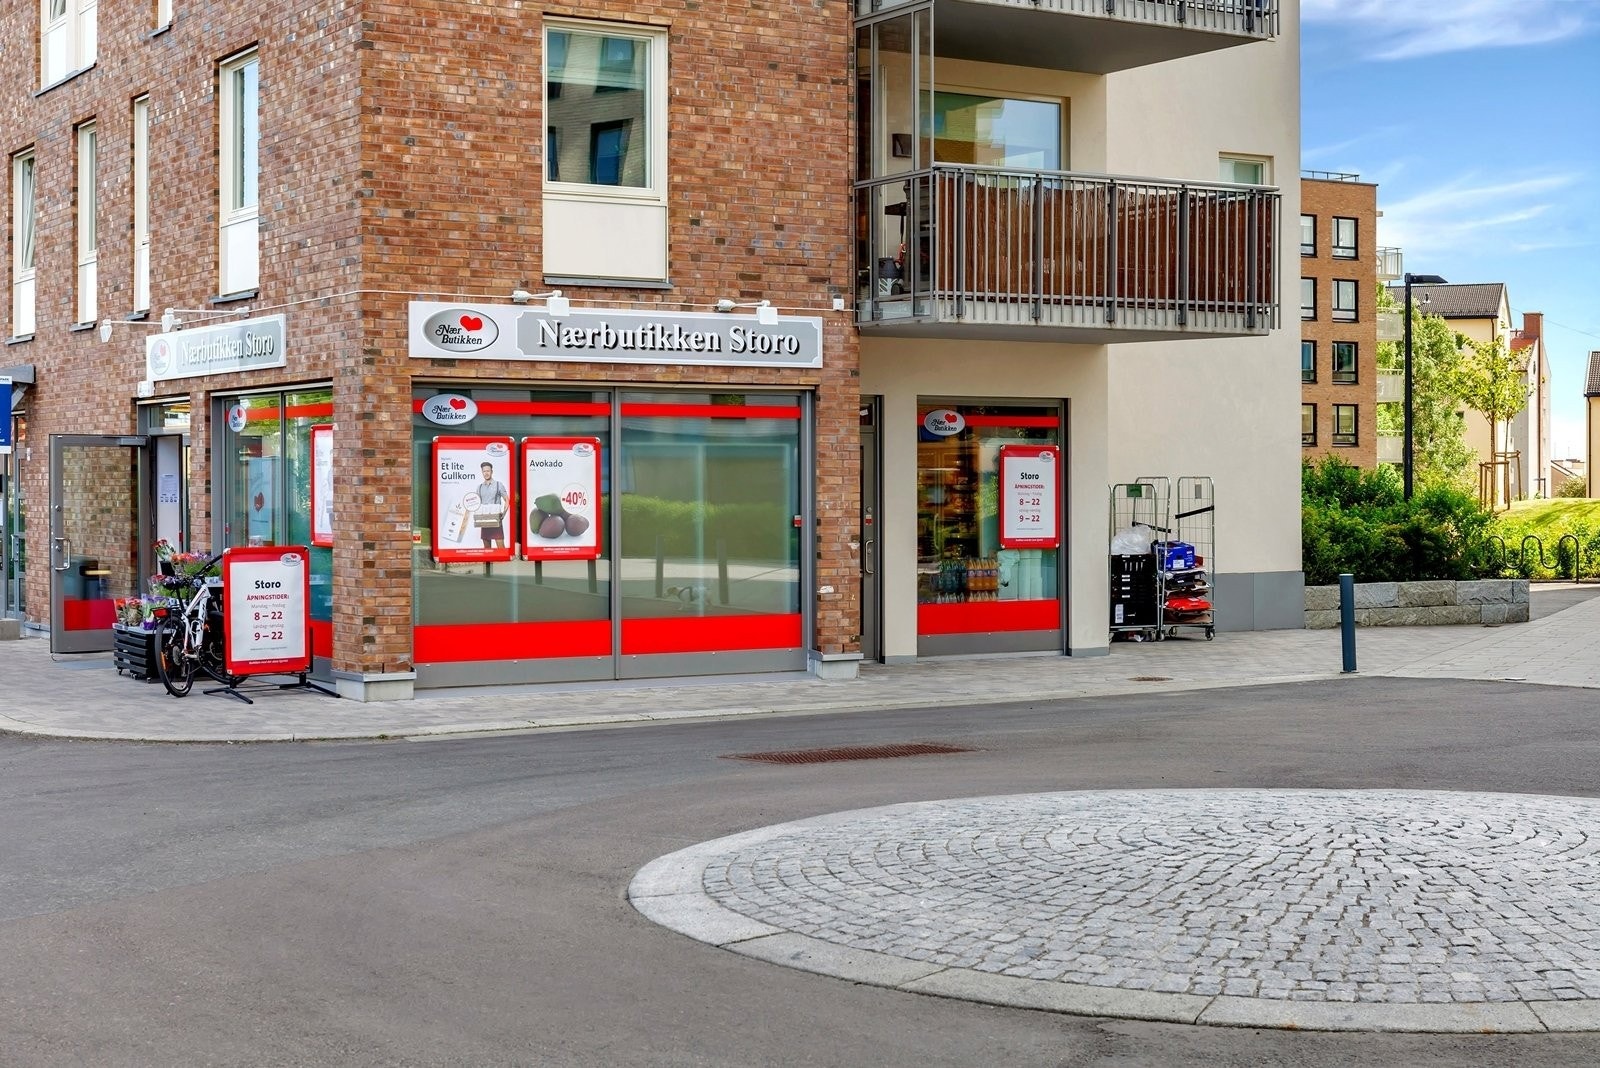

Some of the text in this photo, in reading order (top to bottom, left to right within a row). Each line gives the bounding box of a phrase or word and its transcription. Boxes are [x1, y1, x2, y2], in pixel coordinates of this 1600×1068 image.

[435, 324, 462, 336] Nær
[441, 335, 483, 345] Butikken
[536, 317, 800, 354] Nærbutikken Storo
[181, 335, 243, 366] Nærbutikken
[245, 331, 275, 357] Storo
[431, 405, 452, 414] Nær
[436, 412, 467, 420] Butikken
[441, 462, 465, 470] Et lite
[529, 459, 563, 468] Avokado
[441, 472, 476, 480] Gullkorn
[1020, 472, 1040, 480] Storo
[561, 491, 587, 506] -40%
[1019, 498, 1024, 506] 8
[1031, 498, 1040, 506] 22
[1019, 515, 1024, 523] 9
[254, 580, 281, 589] Storo
[254, 612, 260, 620] 8
[271, 611, 283, 620] 22
[254, 632, 260, 641] 9
[271, 631, 283, 640] 22
